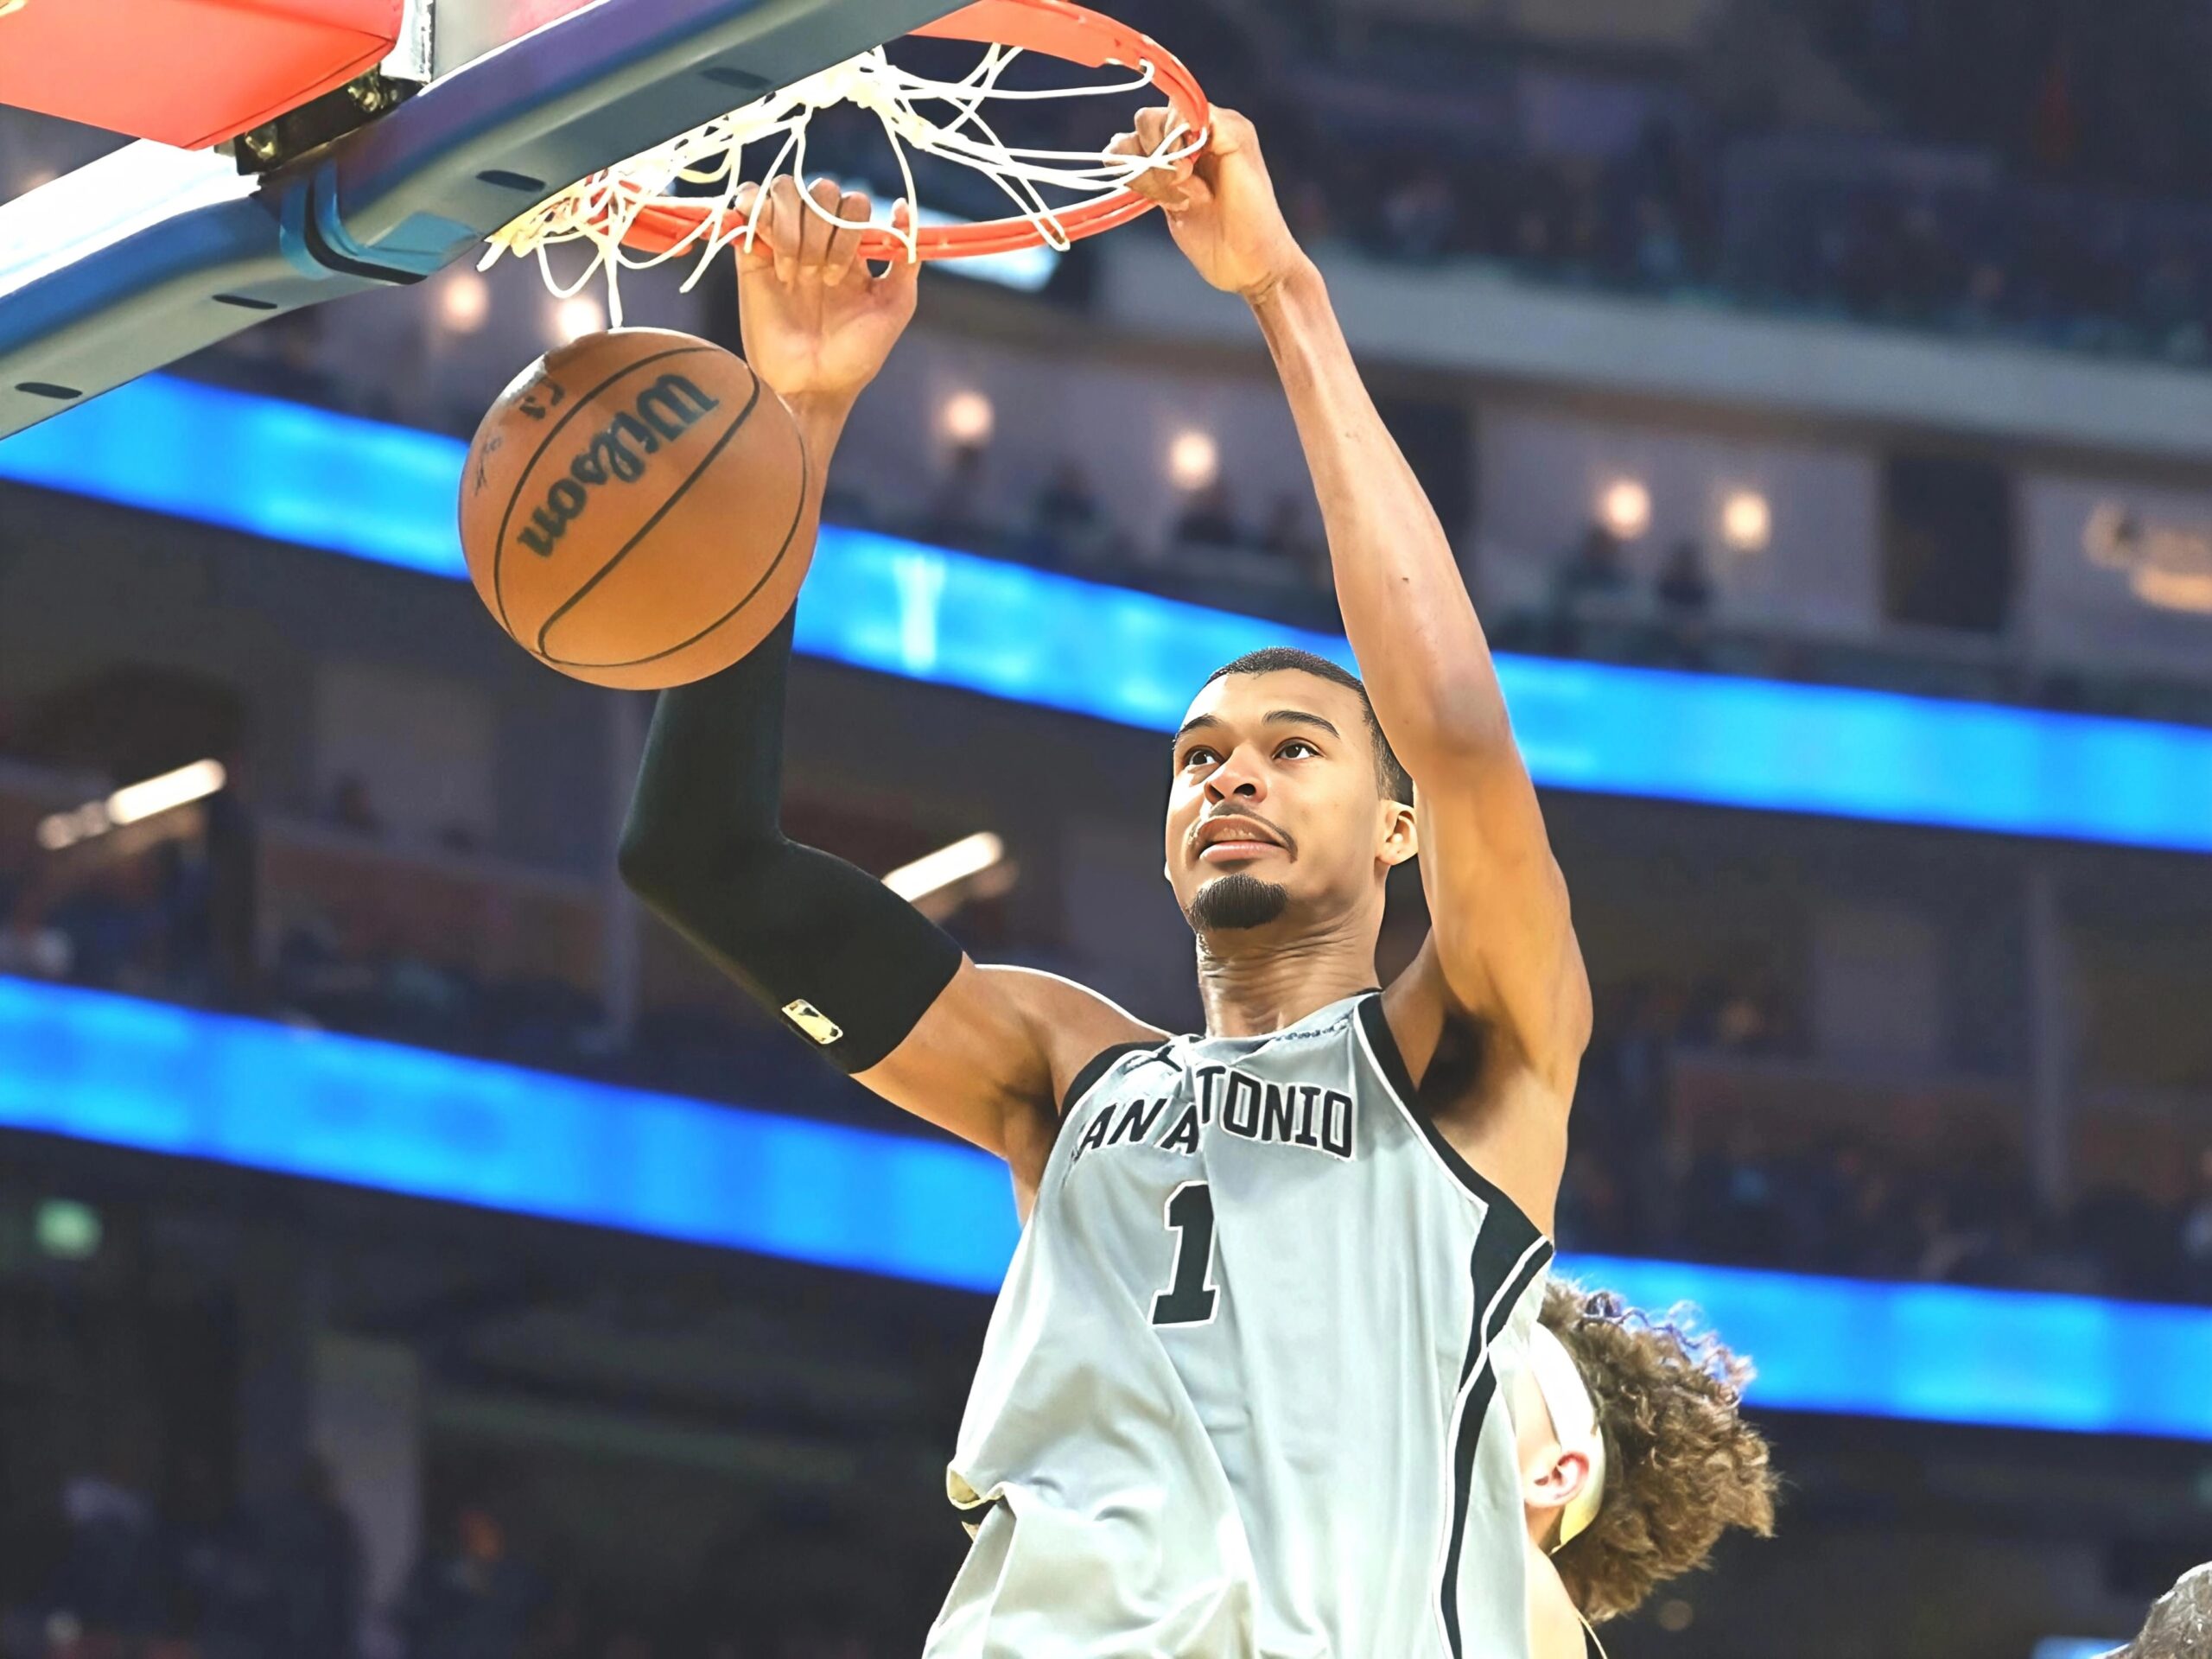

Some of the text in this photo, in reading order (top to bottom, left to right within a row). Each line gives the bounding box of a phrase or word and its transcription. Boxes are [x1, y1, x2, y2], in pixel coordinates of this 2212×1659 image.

[517, 373, 720, 558] Wilson
[1071, 1065, 1354, 1162] AN ATONIO
[1150, 1182, 1218, 1326] 1
